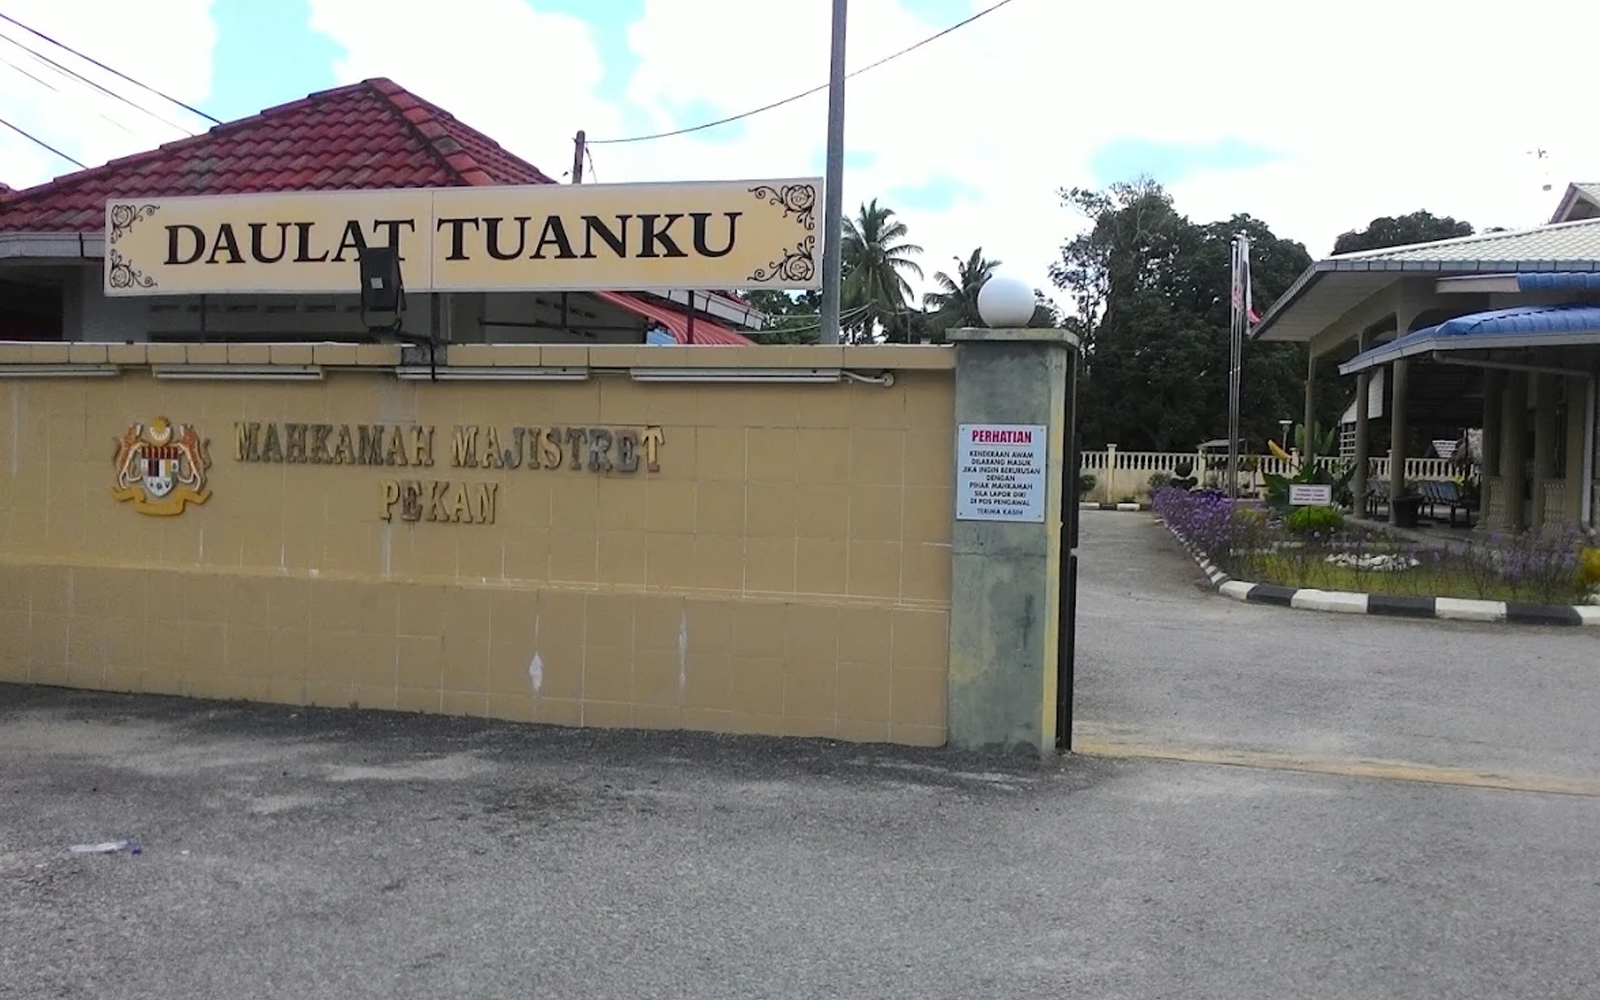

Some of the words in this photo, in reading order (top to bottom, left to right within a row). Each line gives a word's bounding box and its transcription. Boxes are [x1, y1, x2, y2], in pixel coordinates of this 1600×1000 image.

[163, 219, 415, 266] DAULAT
[436, 211, 743, 261] TUANKU
[972, 430, 1032, 443] PERHATIAN
[234, 422, 435, 467] MAHKAMAH
[451, 425, 665, 472] MAJISTRET
[969, 450, 1010, 458] KENDERAAN
[971, 458, 1005, 466] DILARANG
[978, 466, 999, 474] INGIN
[1000, 467, 1041, 475] BERURUSAN
[991, 482, 1033, 490] MAHKAMAH
[989, 490, 1011, 498] LAPOR
[379, 479, 498, 524] PEKAN
[993, 499, 1030, 507] PENGAWAL
